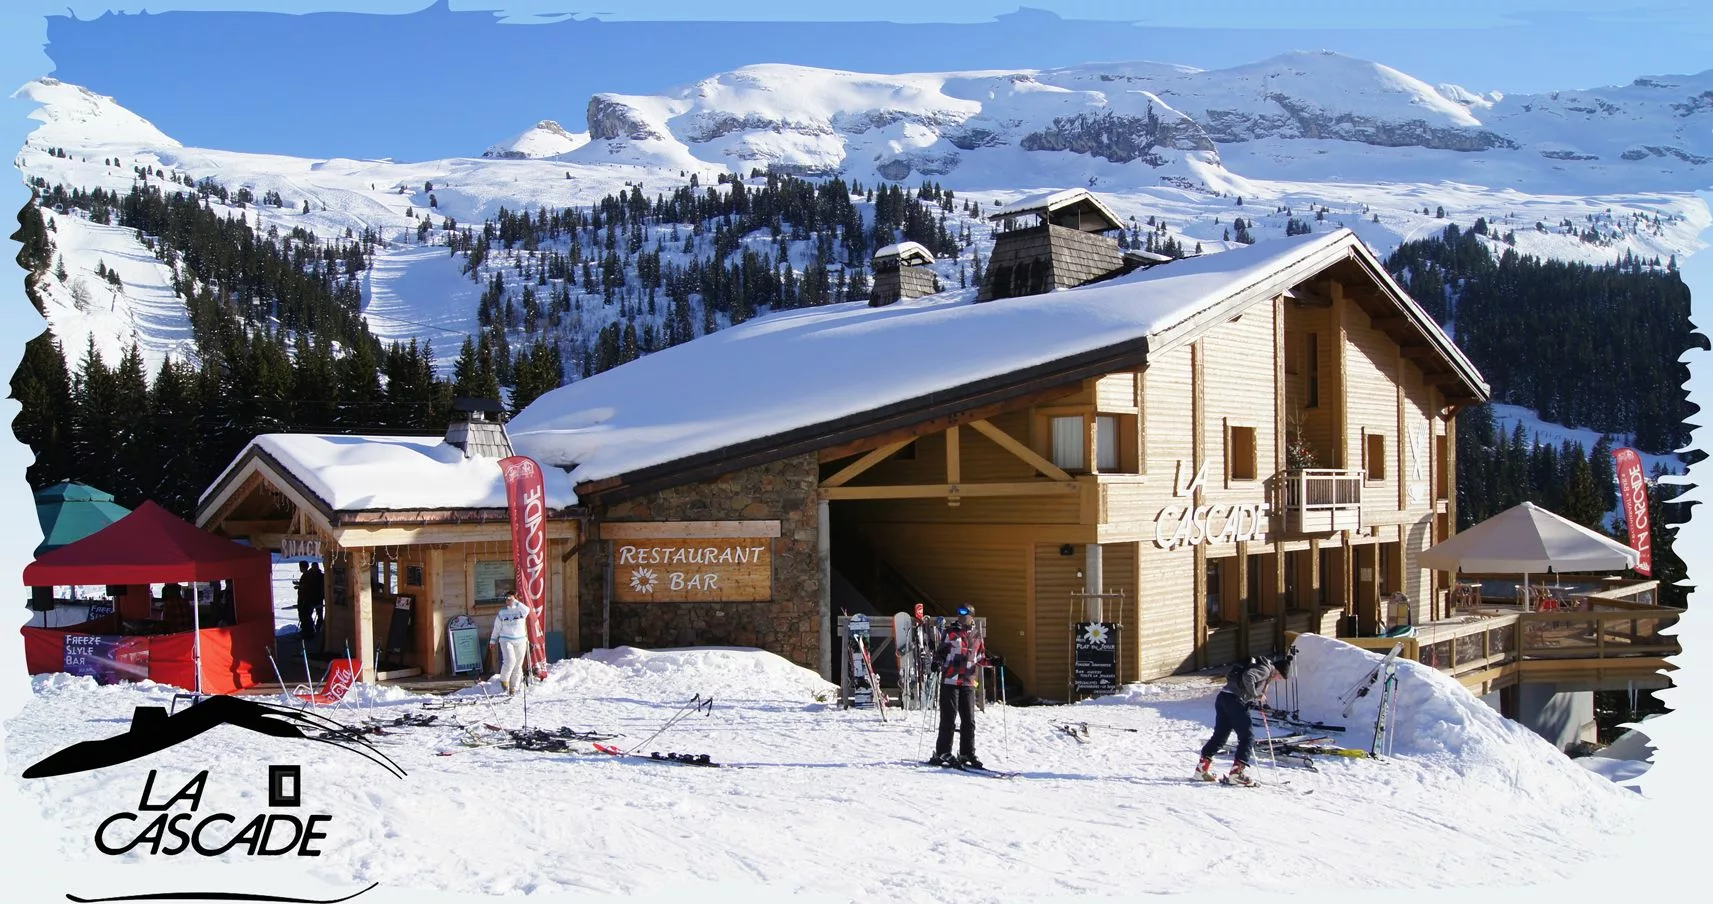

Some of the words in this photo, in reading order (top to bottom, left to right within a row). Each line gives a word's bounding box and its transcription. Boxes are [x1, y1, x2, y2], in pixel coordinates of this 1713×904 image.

[1176, 460, 1209, 497] LA
[1155, 503, 1270, 548] CASCADE
[281, 539, 323, 558] SNACK
[619, 545, 765, 565] RESTAURANT
[669, 572, 718, 591] BAR
[66, 635, 101, 646] FREEZE
[65, 655, 86, 665] BAR
